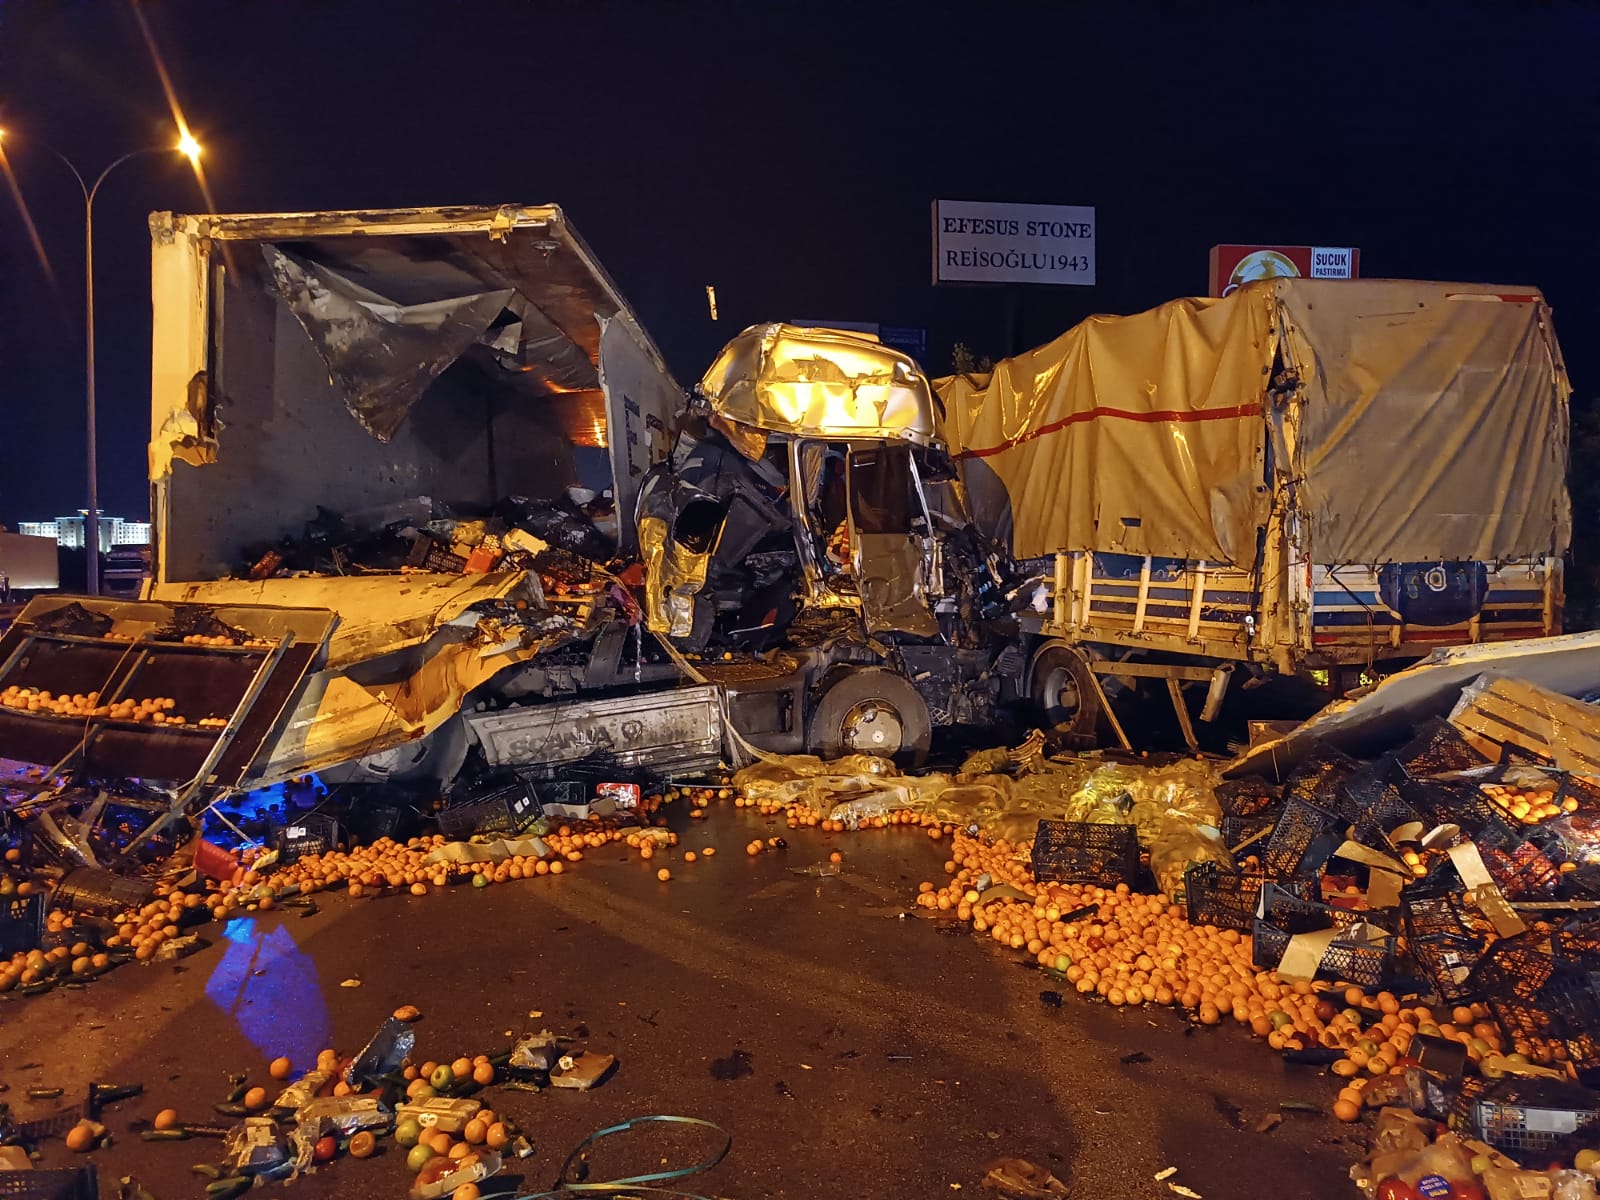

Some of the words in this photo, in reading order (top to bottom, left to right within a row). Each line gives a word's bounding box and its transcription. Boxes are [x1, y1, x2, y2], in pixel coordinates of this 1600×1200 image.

[943, 217, 1019, 236] EFESUS
[1026, 220, 1092, 239] STONE
[1315, 253, 1347, 266] SUCUK
[1315, 267, 1347, 277] PASTIRMA
